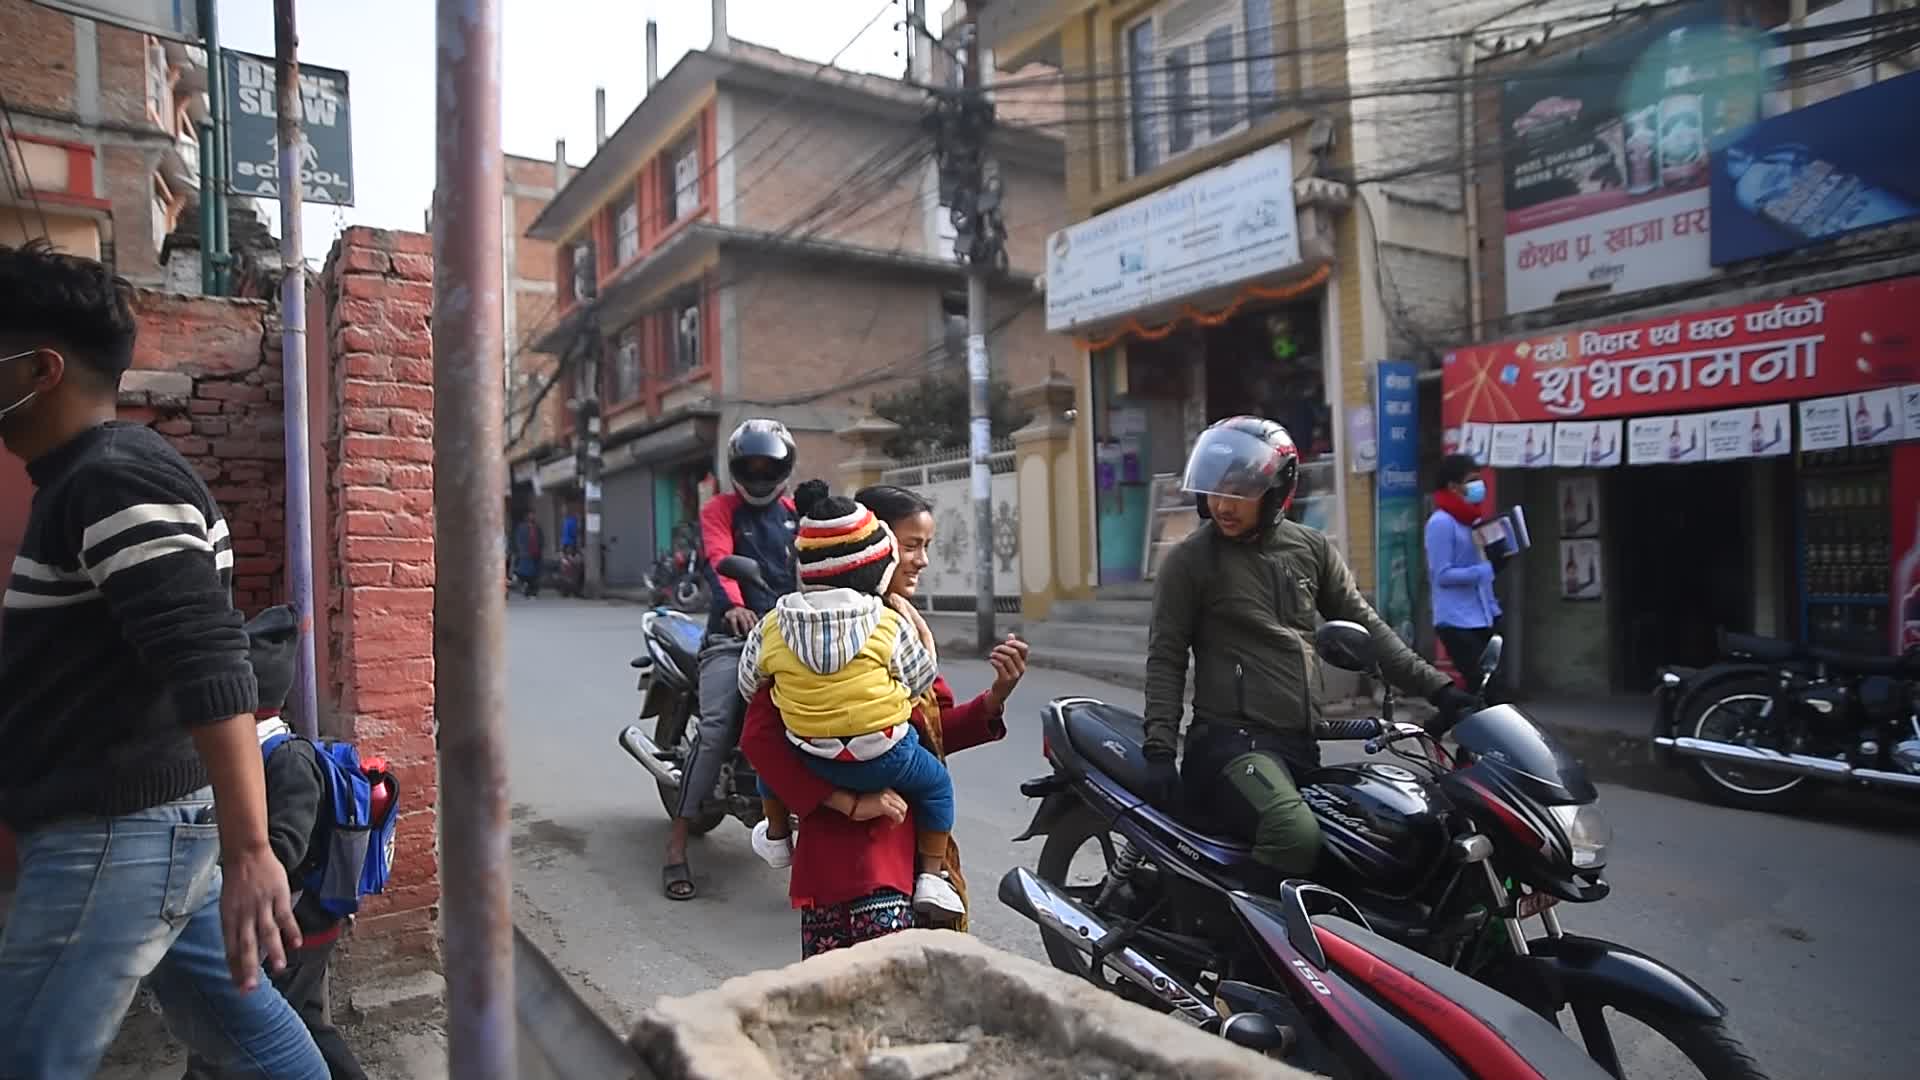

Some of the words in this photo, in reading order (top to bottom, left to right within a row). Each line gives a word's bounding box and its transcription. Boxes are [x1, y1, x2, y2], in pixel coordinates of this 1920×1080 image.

[238, 58, 337, 101] DRVE
[239, 87, 337, 127] SLW
[237, 161, 349, 187] SCOOL
[1605, 217, 1664, 253] खाजा
[1579, 328, 1642, 357] तिहार
[1649, 319, 1681, 346] एवं
[1744, 297, 1827, 332] पर्वको
[1532, 334, 1826, 415] शुभकामना
[1292, 958, 1332, 996] 150
